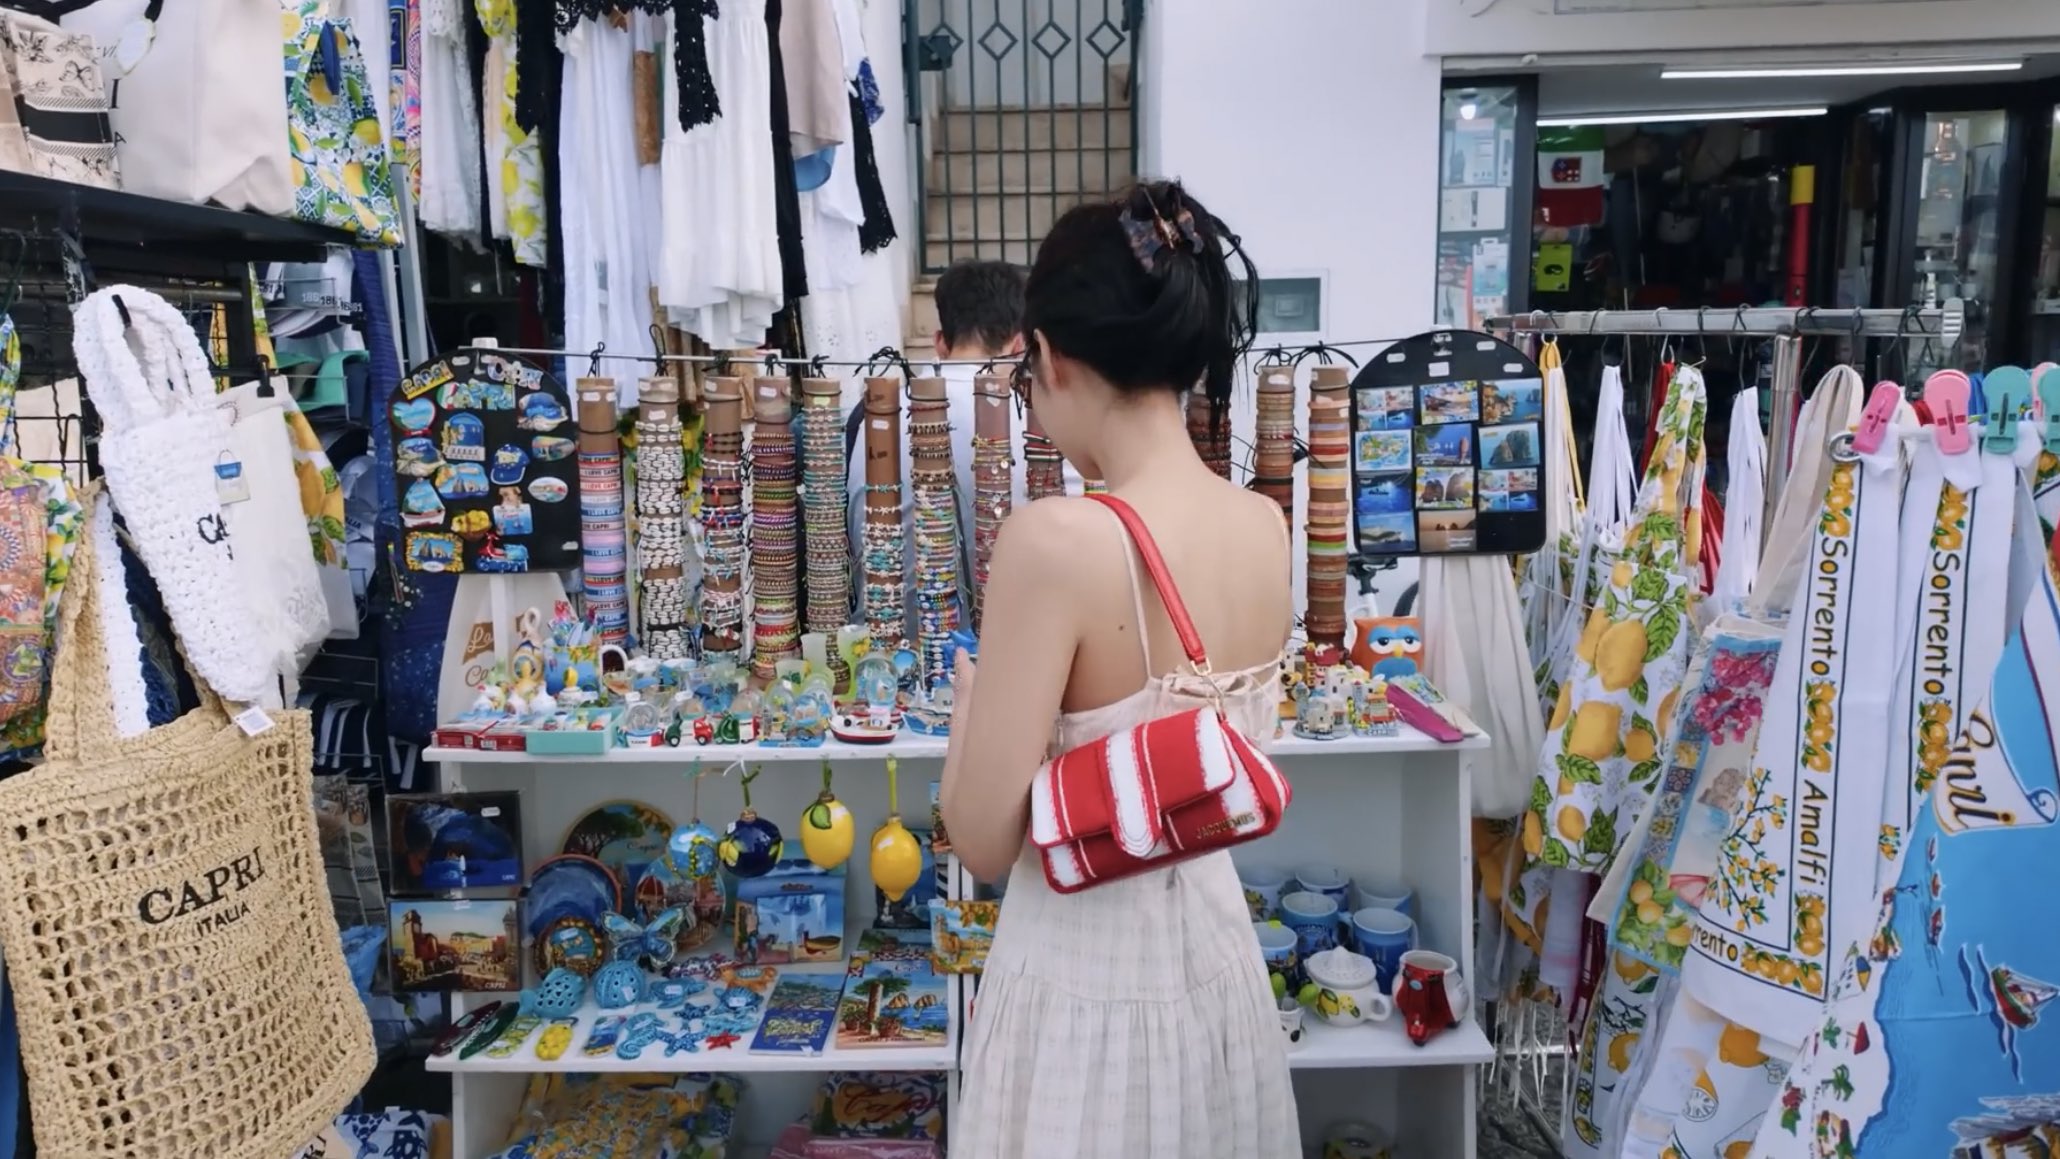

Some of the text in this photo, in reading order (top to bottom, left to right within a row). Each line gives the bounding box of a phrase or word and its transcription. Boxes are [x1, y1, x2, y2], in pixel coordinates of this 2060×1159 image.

[1811, 537, 1848, 676] Sorrento
[1924, 551, 1960, 695] Sorrento
[137, 846, 265, 924] CAPRI
[1798, 779, 1829, 886] Amalfi
[195, 901, 251, 937] ITALIA
